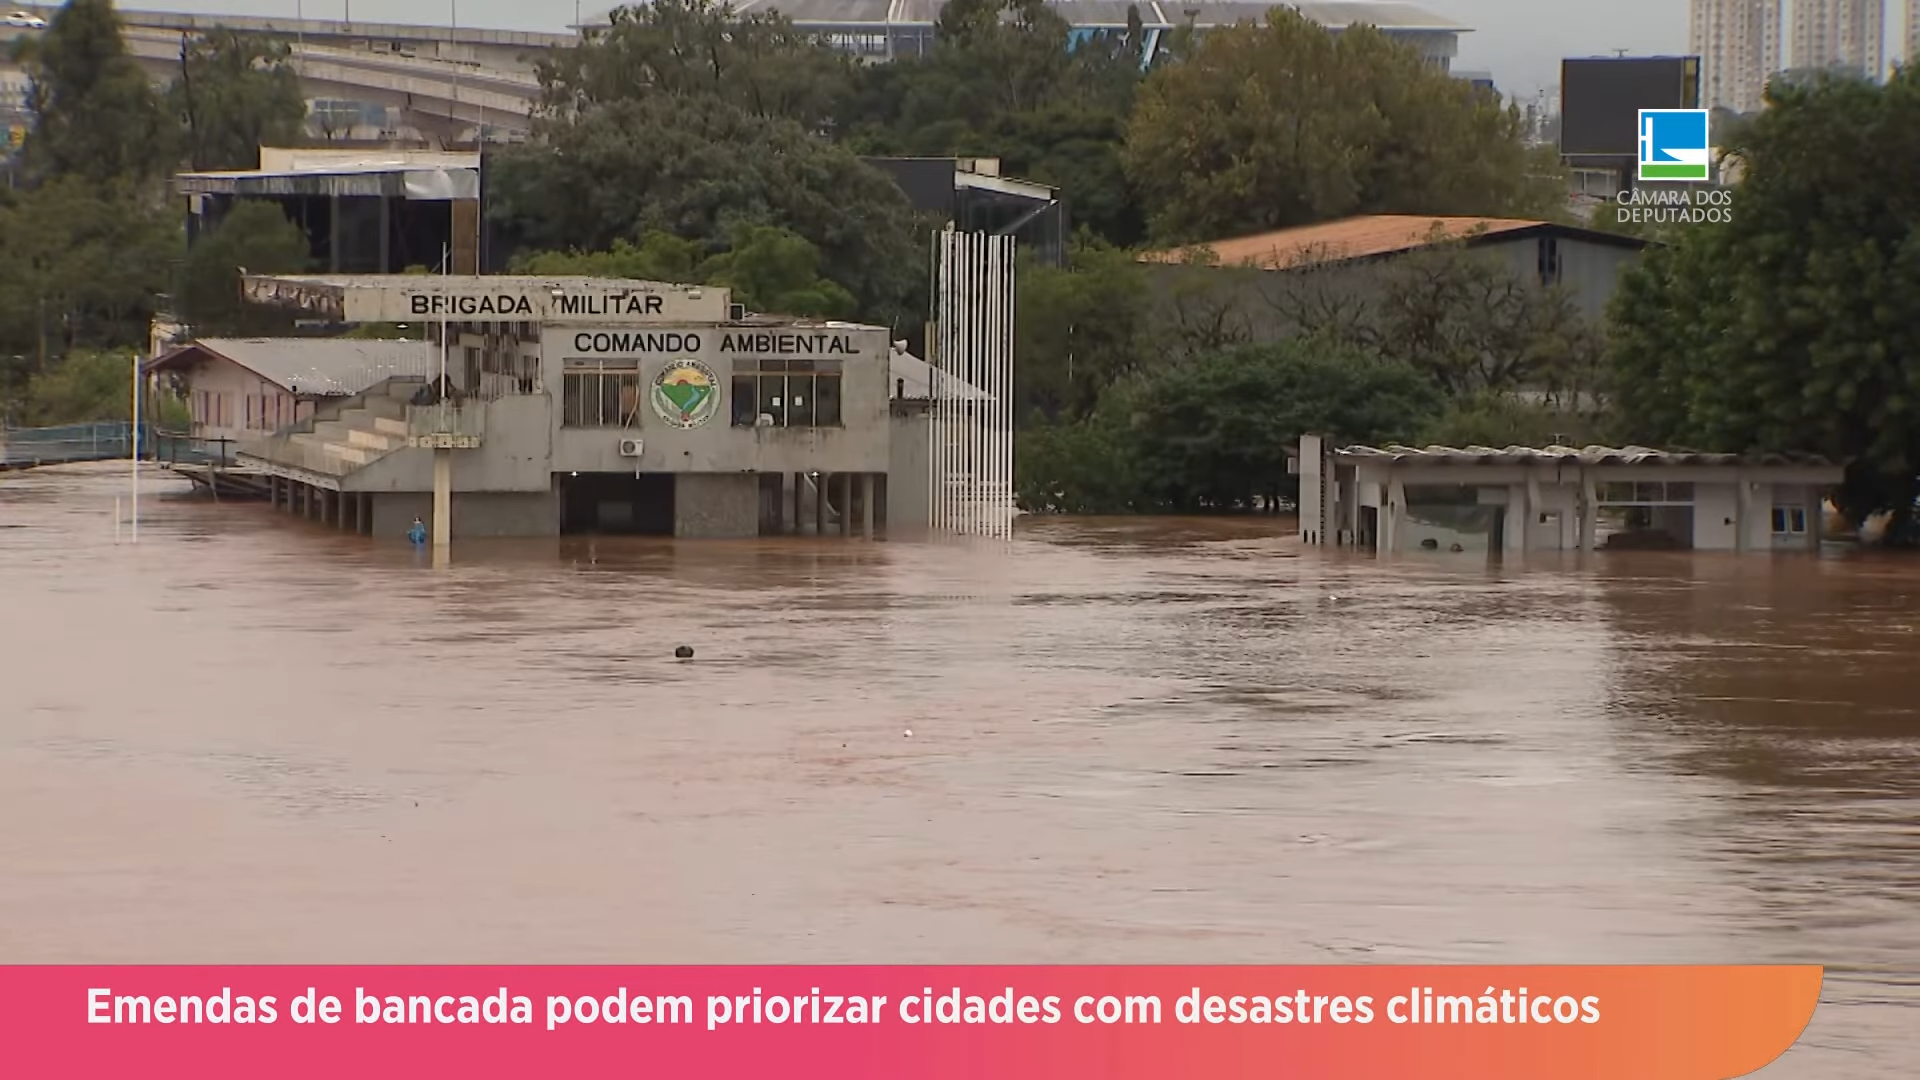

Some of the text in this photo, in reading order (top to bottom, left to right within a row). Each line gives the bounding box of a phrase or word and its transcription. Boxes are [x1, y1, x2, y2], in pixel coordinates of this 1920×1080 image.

[411, 295, 664, 315] BRIGADA MILITAR
[574, 332, 861, 354] COMANDO AMBIENTAL
